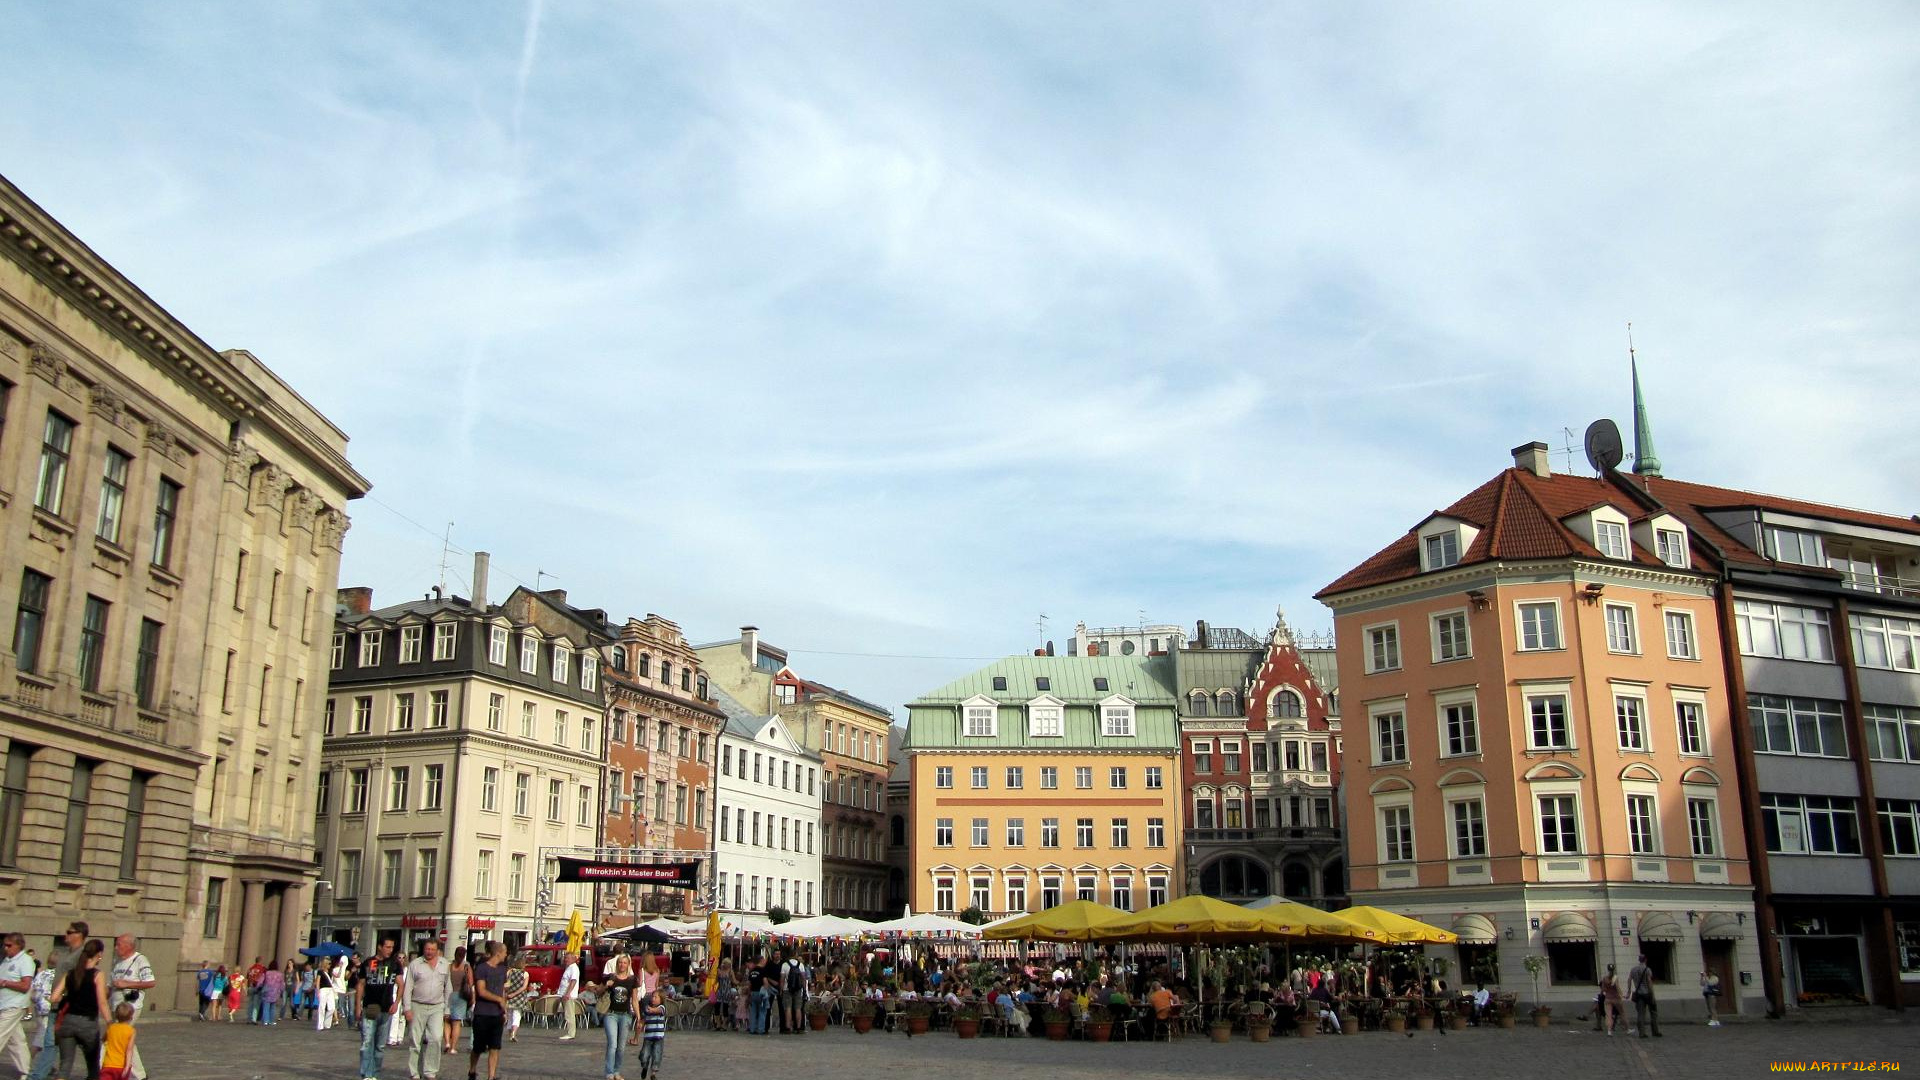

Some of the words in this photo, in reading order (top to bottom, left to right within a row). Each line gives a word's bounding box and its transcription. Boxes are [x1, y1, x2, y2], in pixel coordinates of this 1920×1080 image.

[585, 867, 627, 876] Mitrokhin's
[628, 869, 653, 877] Master
[655, 869, 674, 877] Band
